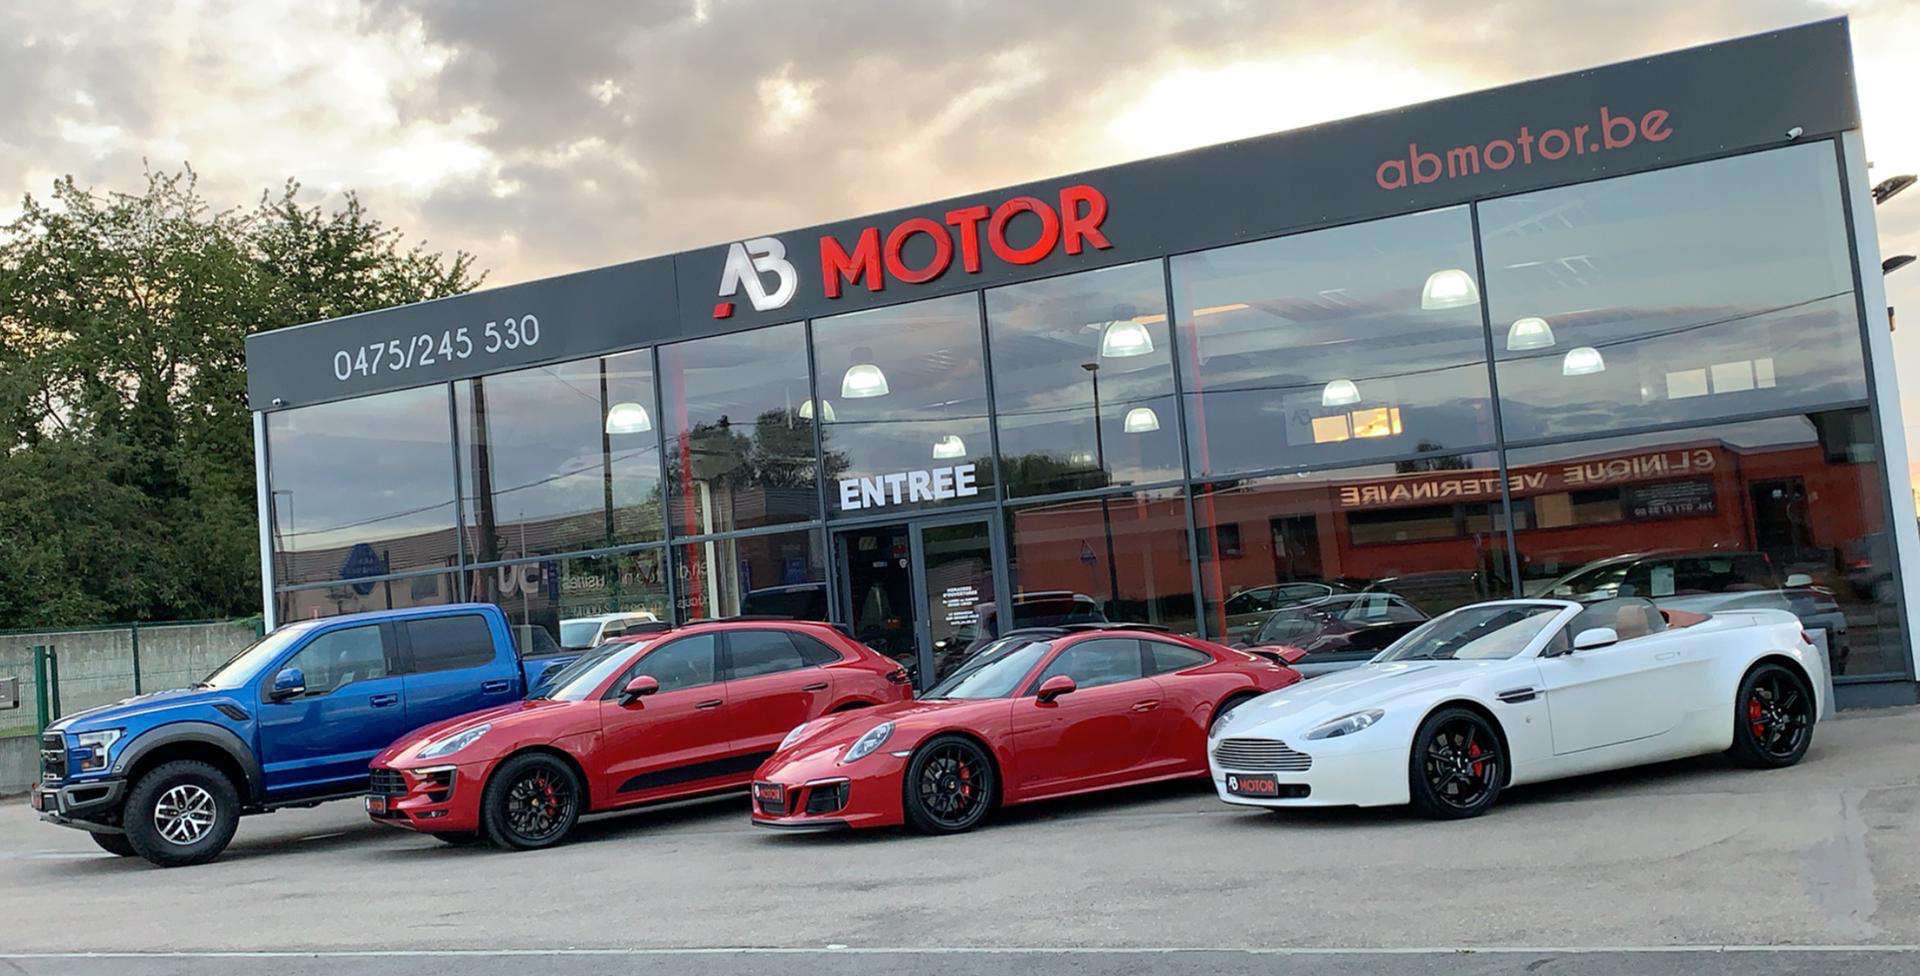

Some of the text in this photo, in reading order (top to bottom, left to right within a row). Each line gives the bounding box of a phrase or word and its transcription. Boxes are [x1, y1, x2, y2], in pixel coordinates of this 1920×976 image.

[1376, 107, 1672, 190] abmotor.be
[713, 185, 1111, 319] AB MOTOR
[333, 313, 541, 382] 0475/245 530
[839, 463, 979, 511] ENTREE
[1239, 779, 1275, 793] MOTOR
